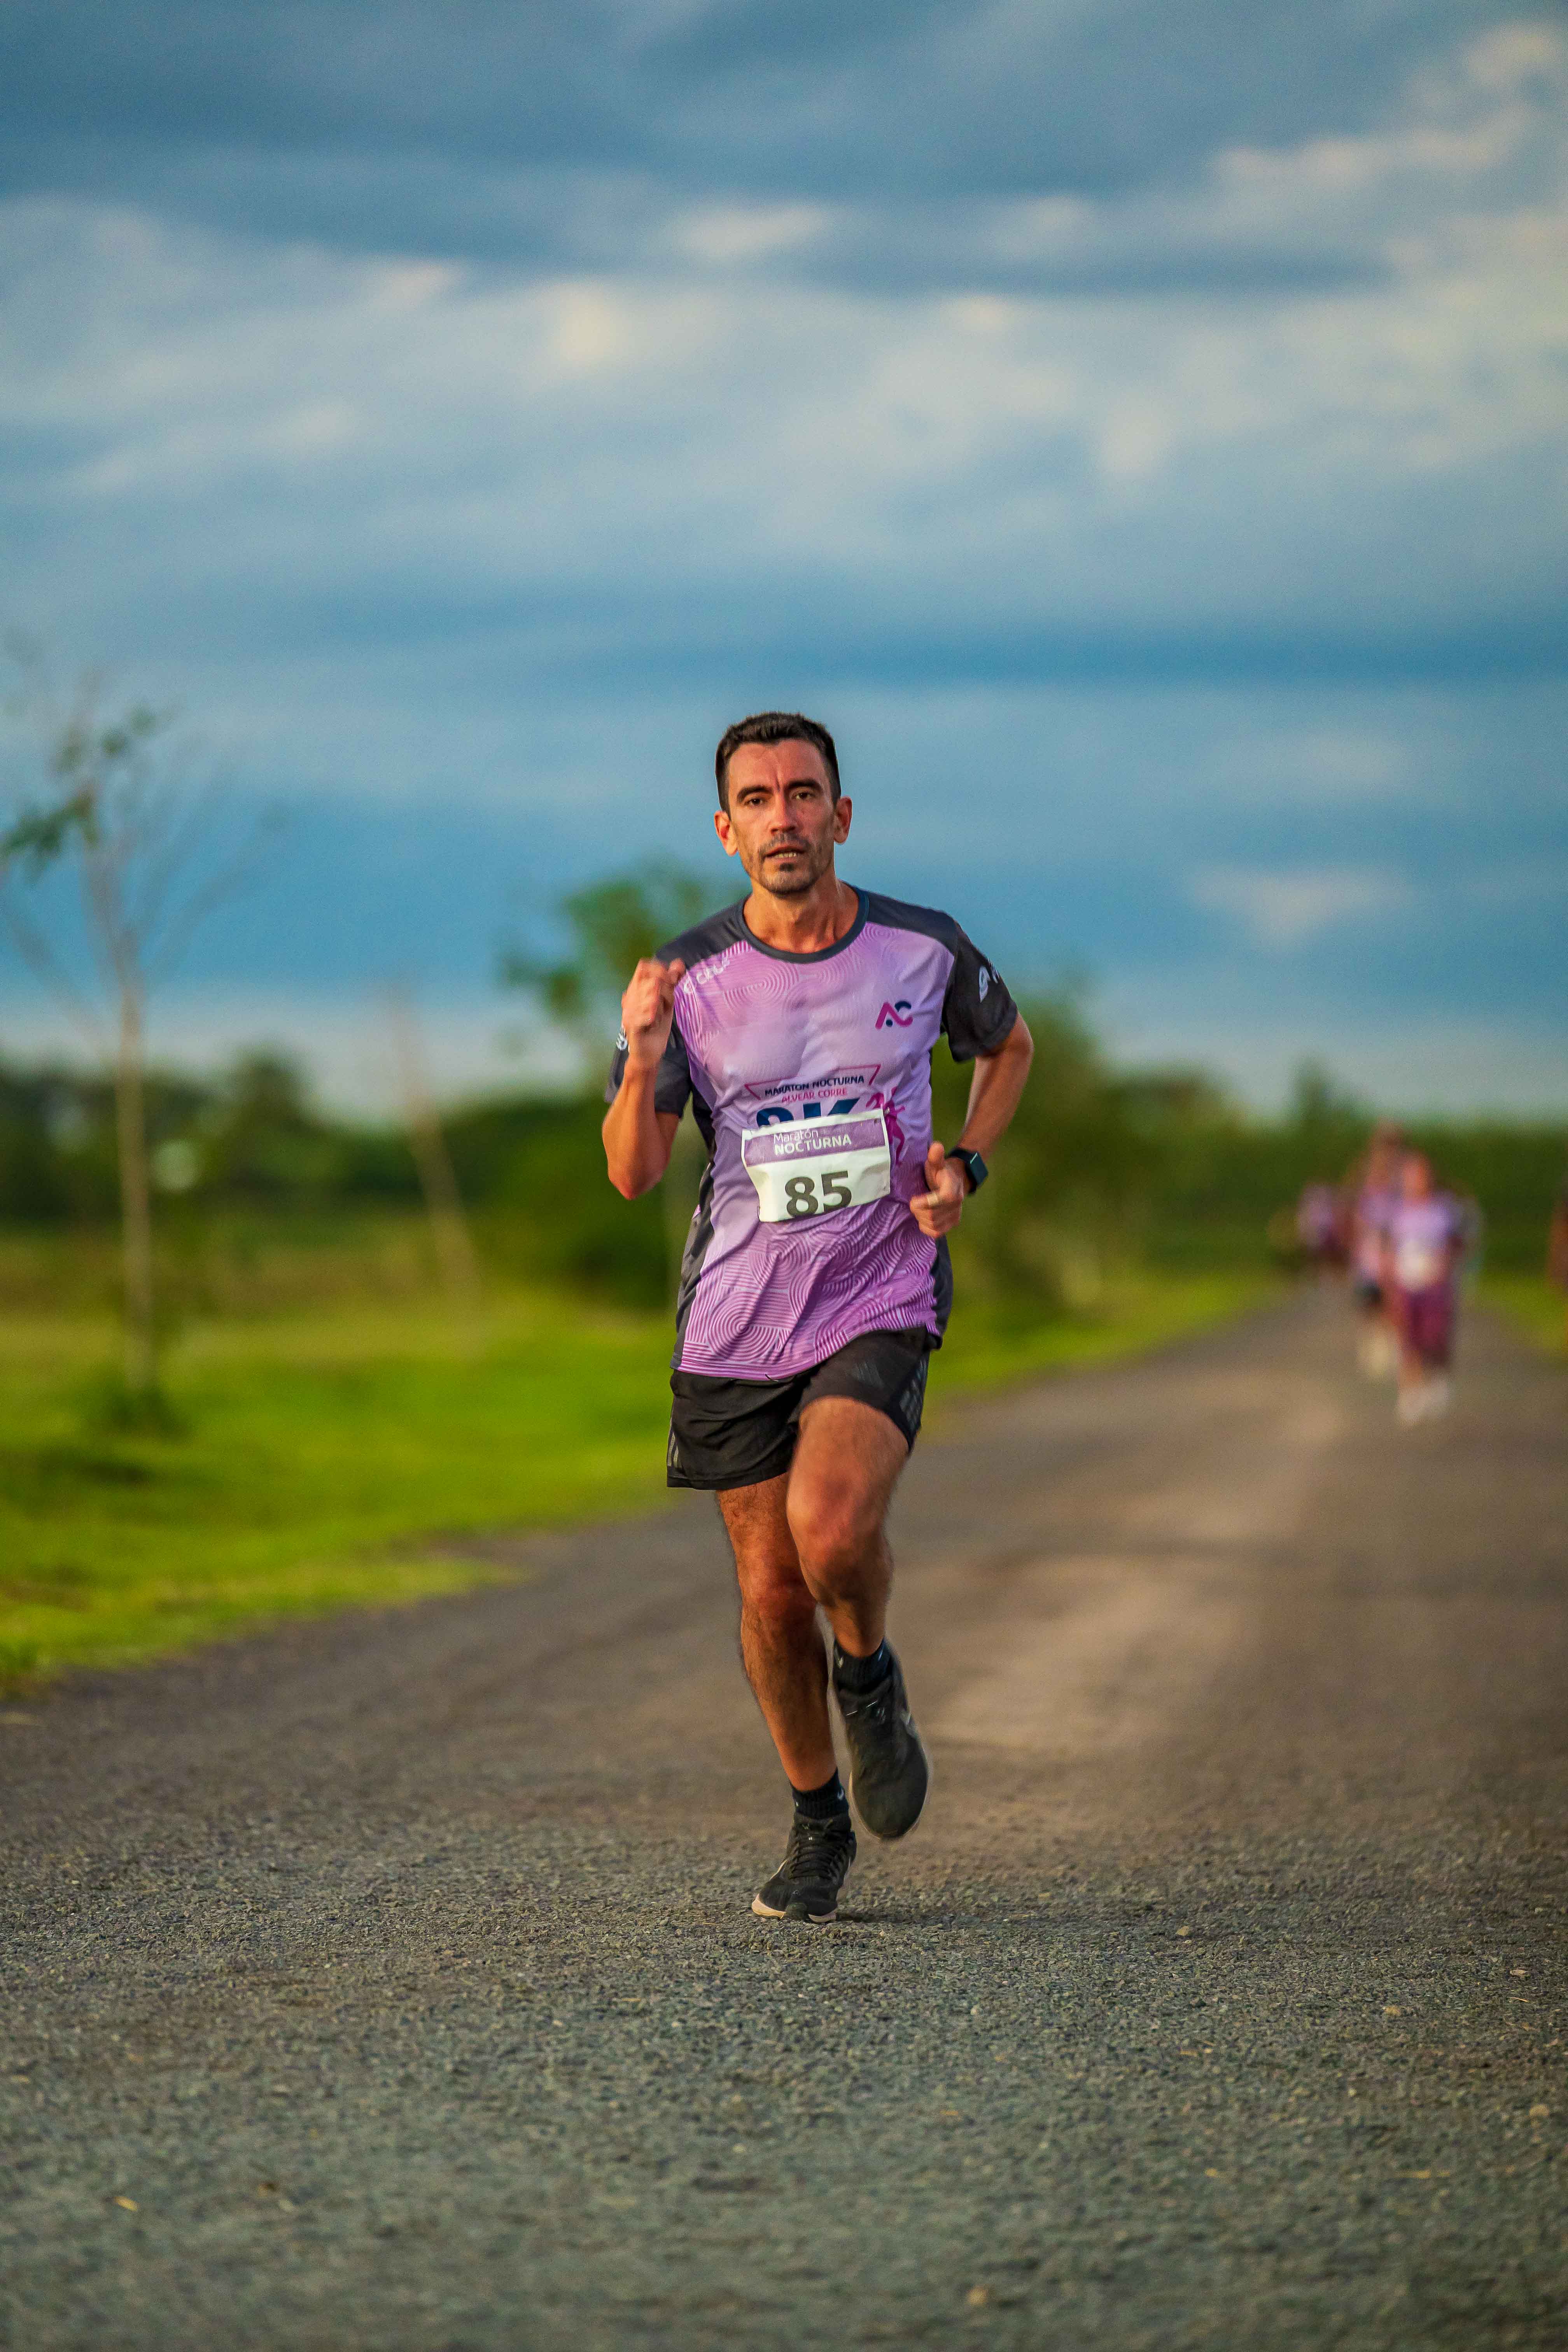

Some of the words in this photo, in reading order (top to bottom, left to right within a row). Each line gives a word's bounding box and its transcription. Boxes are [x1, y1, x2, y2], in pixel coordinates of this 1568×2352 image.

[812, 1075, 864, 1088] NOCTURNA
[781, 1092, 815, 1103] ALVEAR
[817, 1088, 848, 1099] CORRE
[774, 1129, 818, 1143] Maratón
[774, 1133, 852, 1155] NOCTURNA
[785, 1170, 852, 1217] 85
